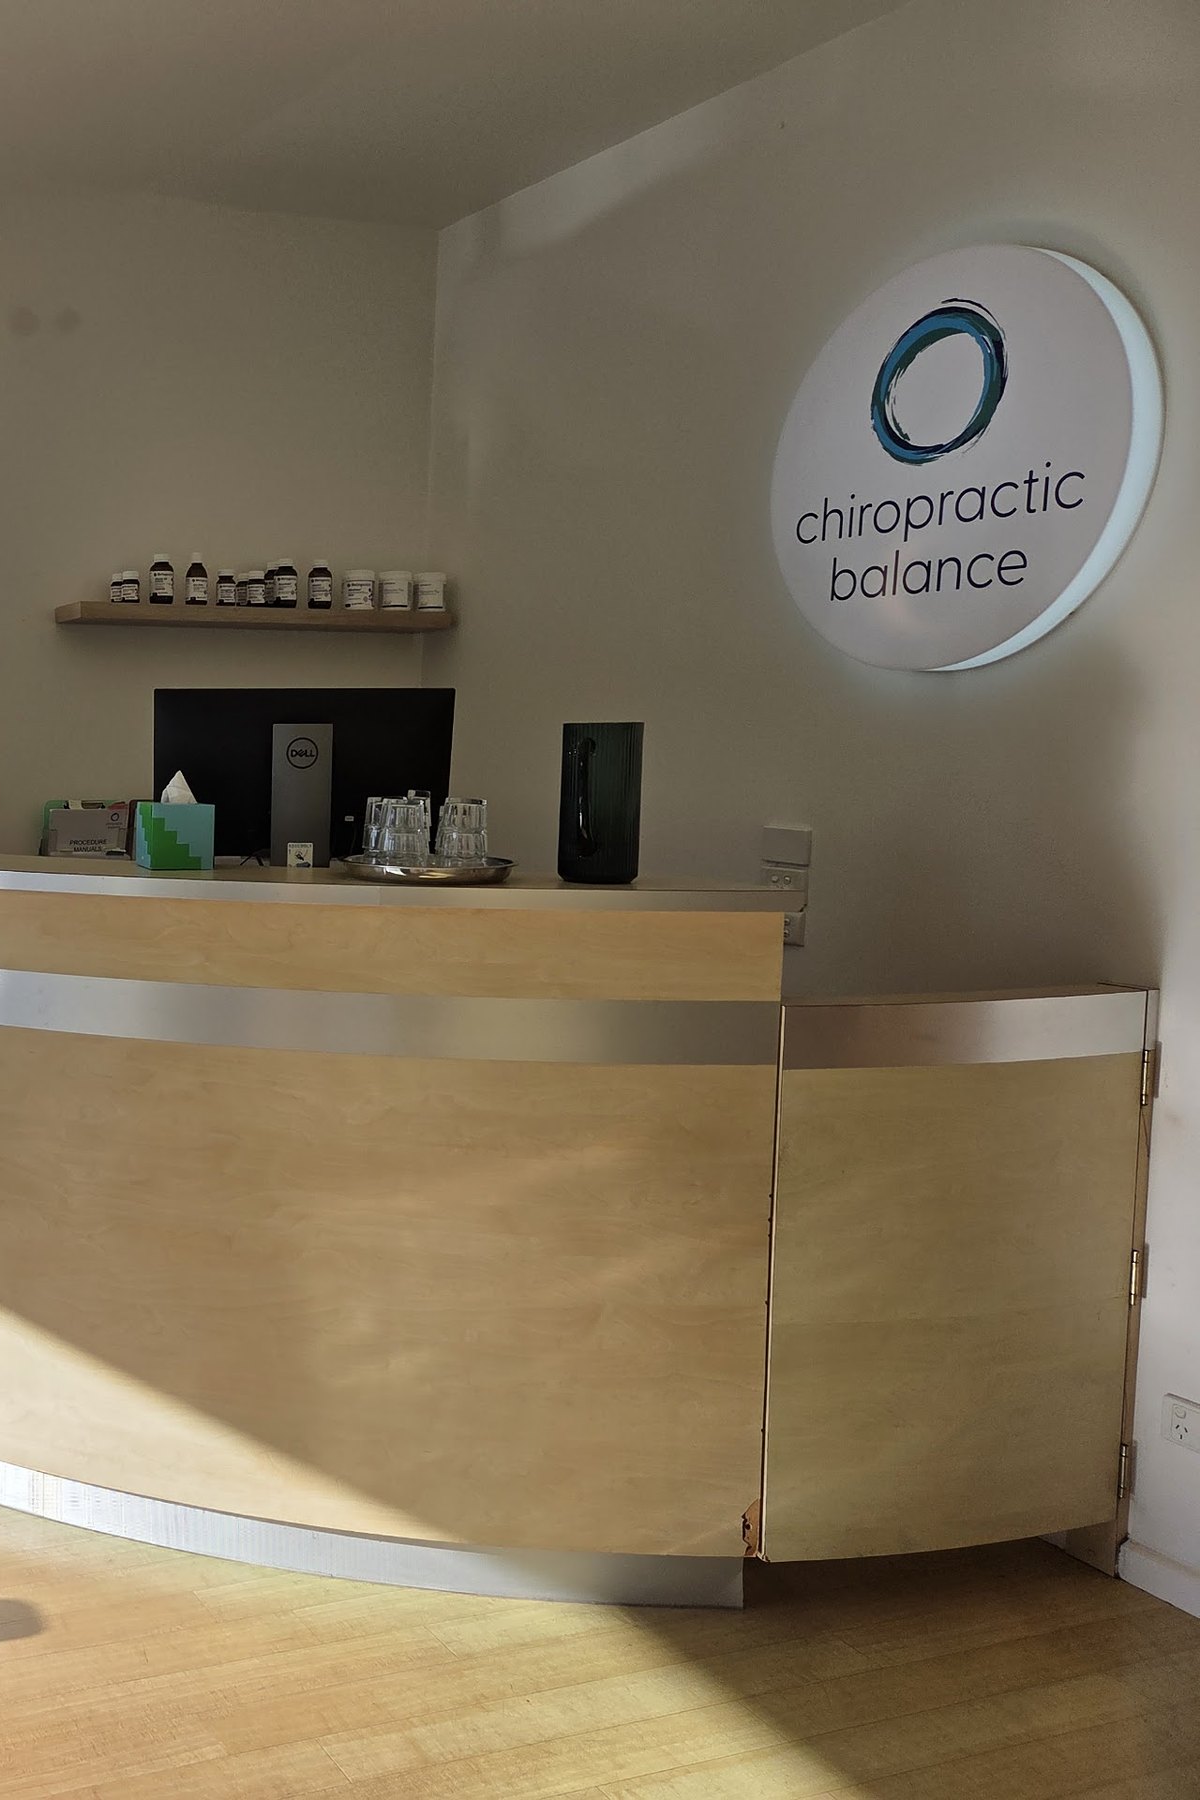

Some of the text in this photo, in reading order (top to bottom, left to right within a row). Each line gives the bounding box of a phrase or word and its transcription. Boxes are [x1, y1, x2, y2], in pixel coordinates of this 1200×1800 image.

[796, 461, 1086, 543] chiropractic
[830, 549, 1028, 602] balance
[290, 749, 315, 757] DELL
[69, 838, 108, 846] PROCEDURE
